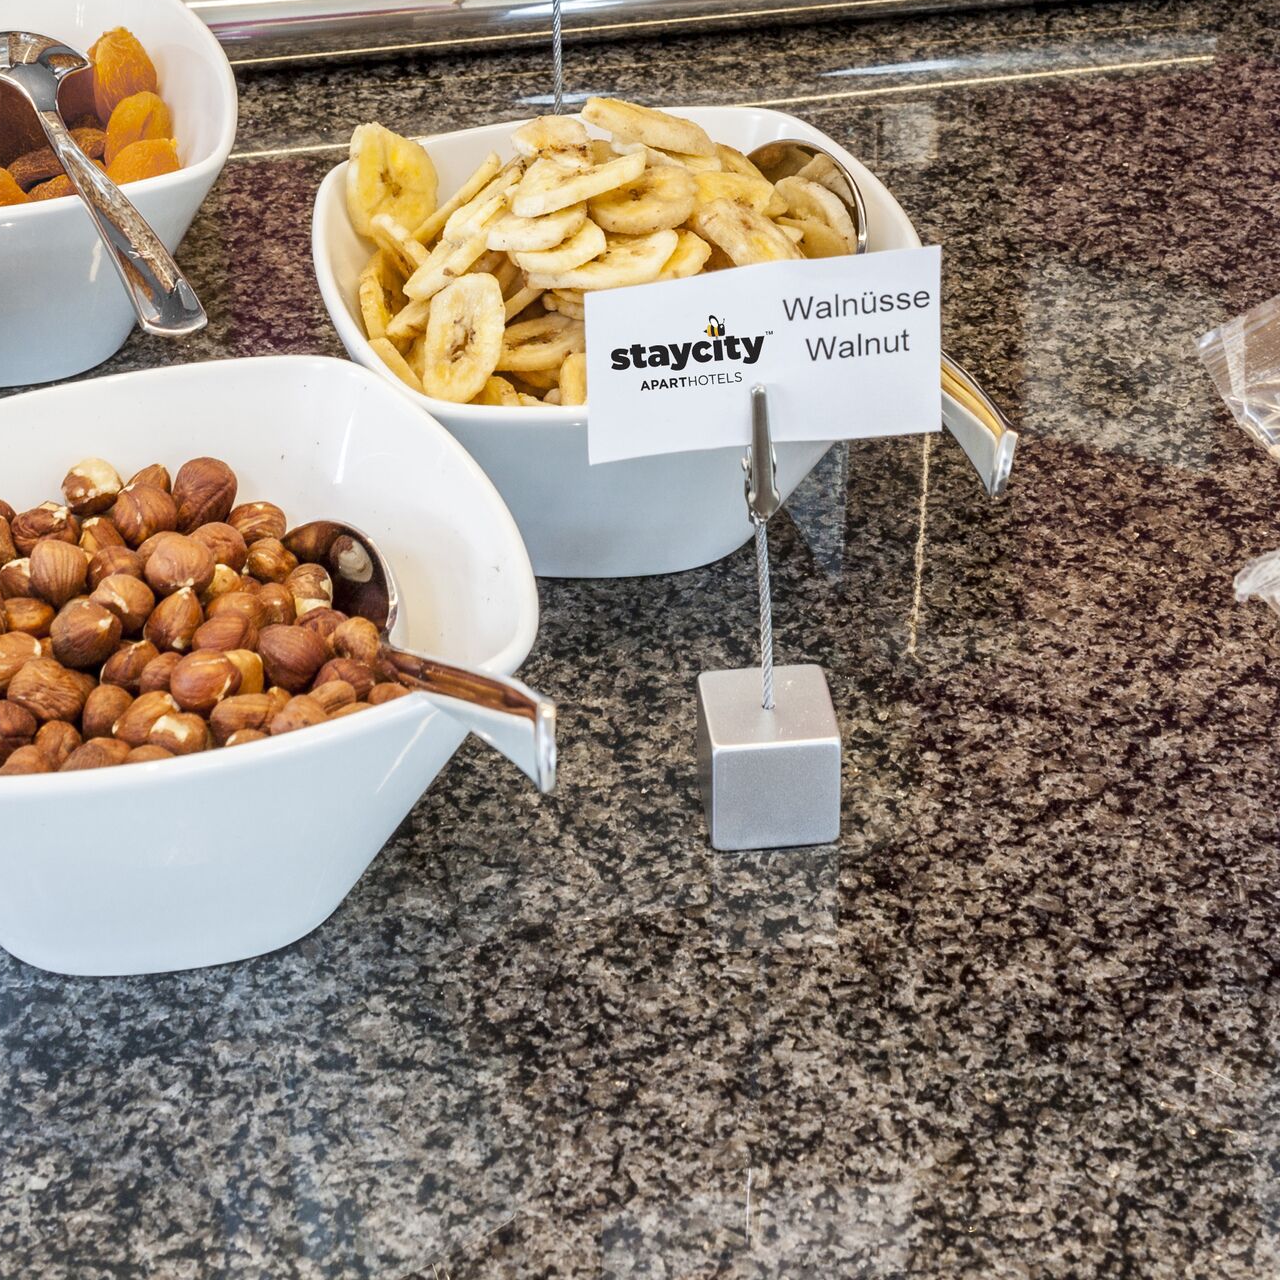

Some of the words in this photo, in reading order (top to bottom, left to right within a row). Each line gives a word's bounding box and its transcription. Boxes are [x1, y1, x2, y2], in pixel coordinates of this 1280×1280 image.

[782, 290, 931, 322] Walnüsse
[805, 328, 910, 362] Walnut
[640, 371, 743, 392] APARTHOTELS
